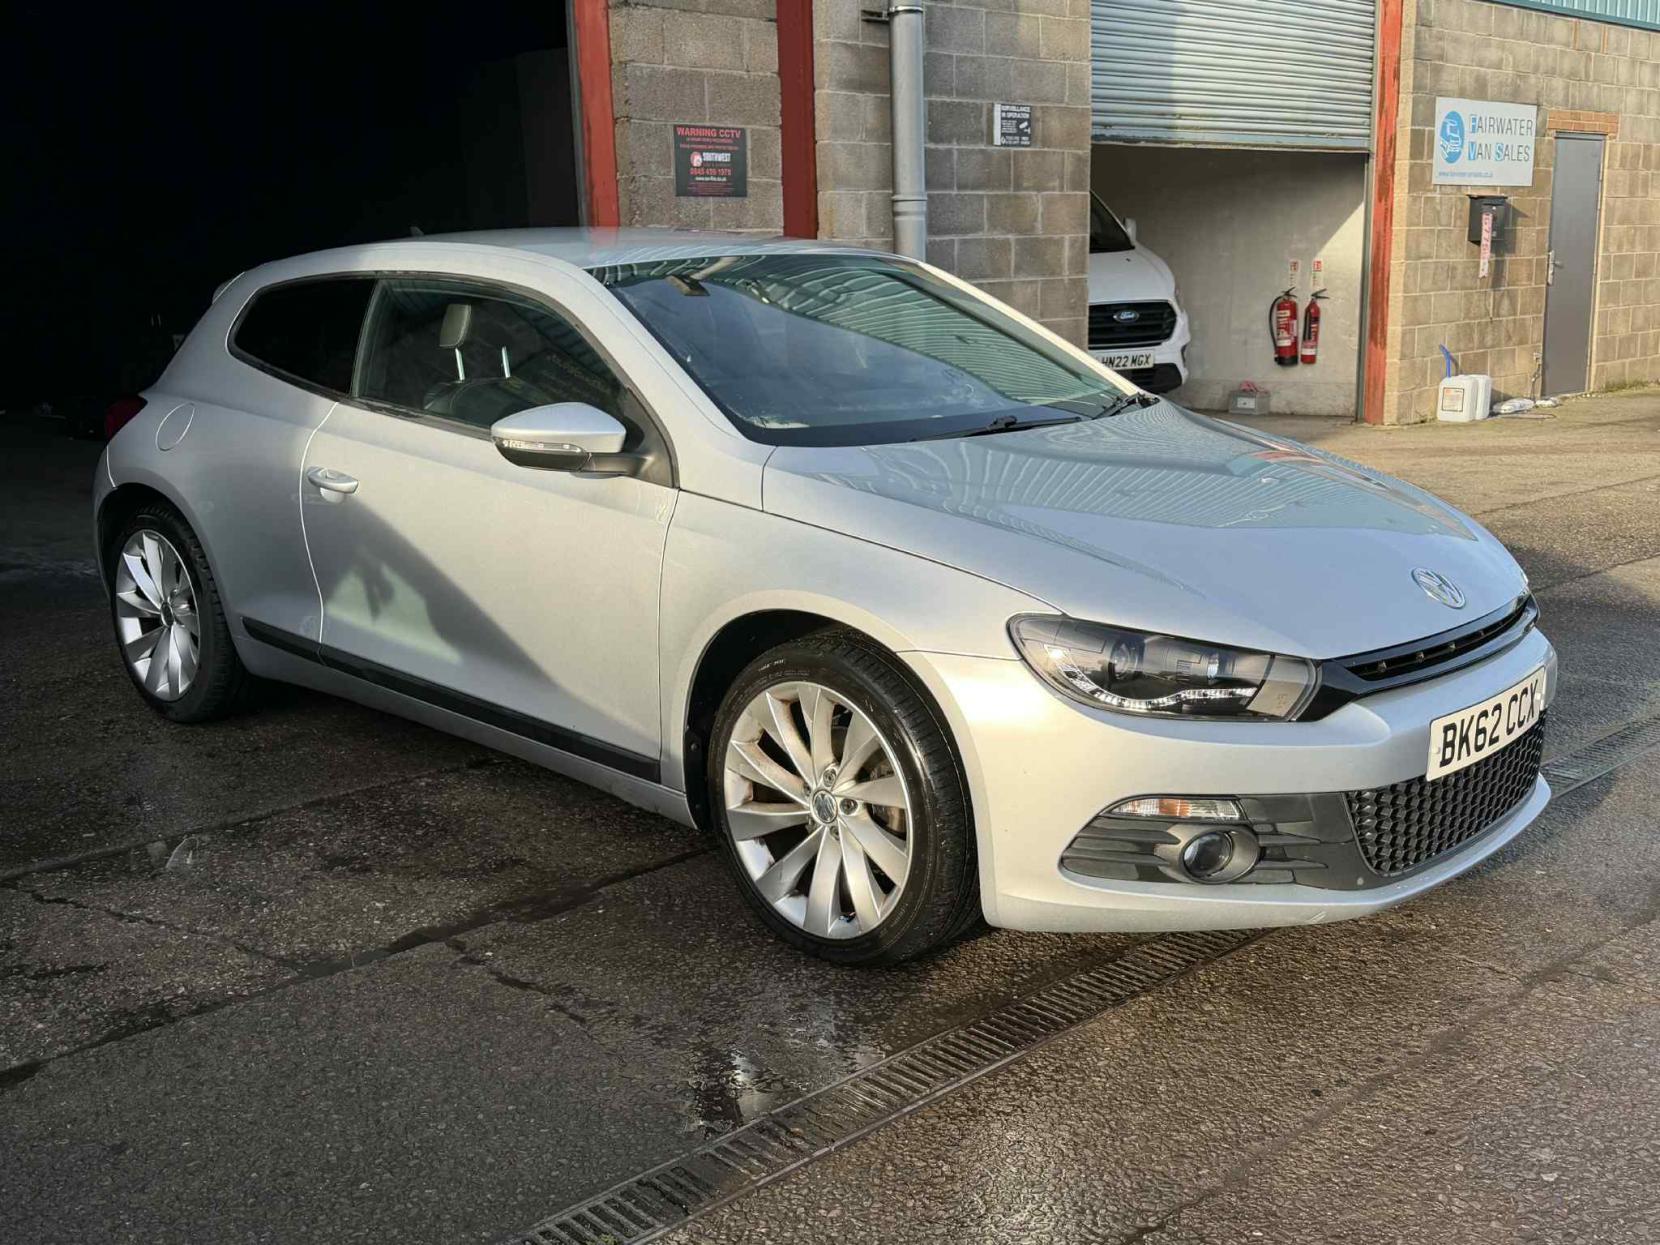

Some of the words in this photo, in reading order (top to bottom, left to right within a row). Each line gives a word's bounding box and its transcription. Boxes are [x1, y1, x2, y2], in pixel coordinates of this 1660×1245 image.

[676, 127, 717, 137] WARNING
[719, 129, 741, 138] CCTV
[1469, 115, 1533, 136] FAIRWATER
[1468, 143, 1492, 161] VAN
[1496, 144, 1530, 162] SALES
[1120, 311, 1136, 319] Ford
[1102, 356, 1129, 368] HN22
[1131, 353, 1151, 366] MGX
[1439, 703, 1503, 768] BK62
[1505, 679, 1539, 736] CCX
